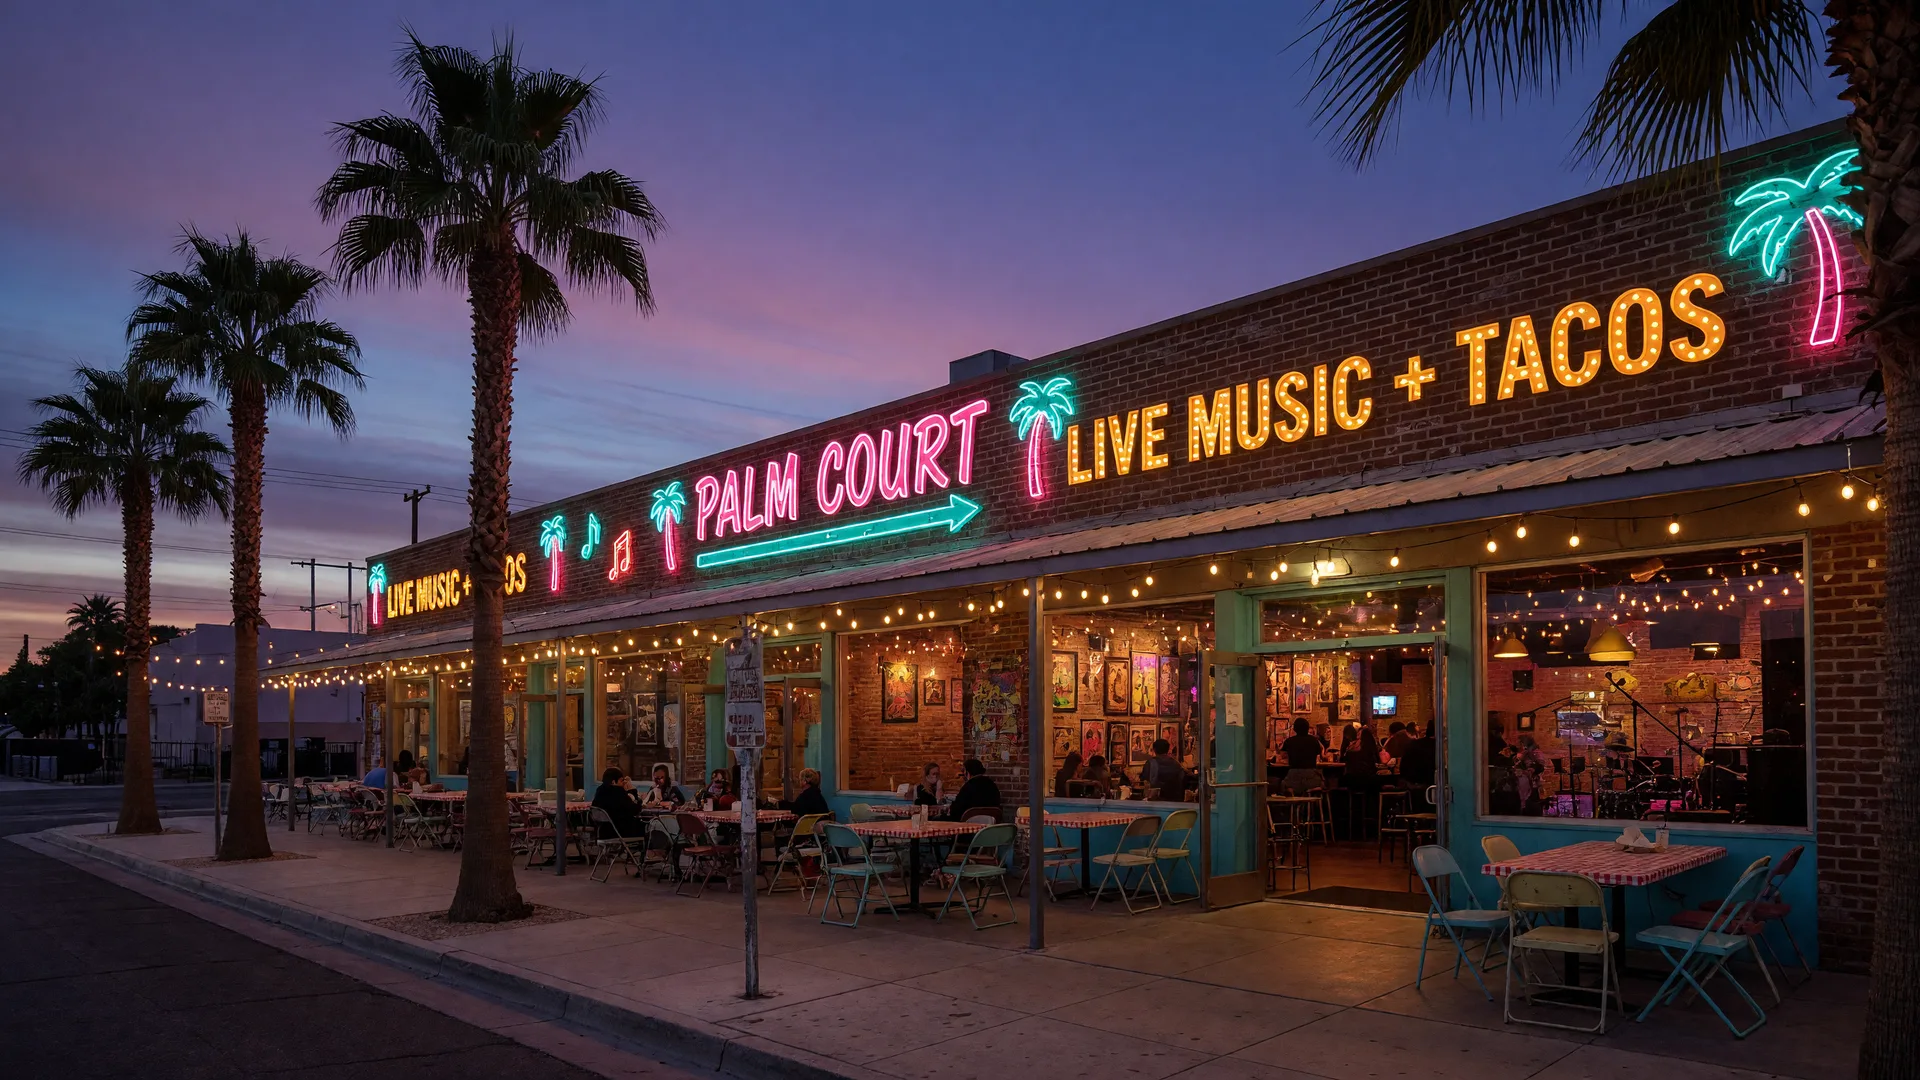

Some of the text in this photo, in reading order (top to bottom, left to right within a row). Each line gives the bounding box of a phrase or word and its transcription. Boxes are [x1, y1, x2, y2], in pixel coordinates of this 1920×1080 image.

[1067, 273, 1726, 486] LIVE MUSIC + TACOS
[695, 399, 990, 541] PALM COURT
[387, 580, 414, 619] LIVE
[416, 569, 460, 613] MUSIC
